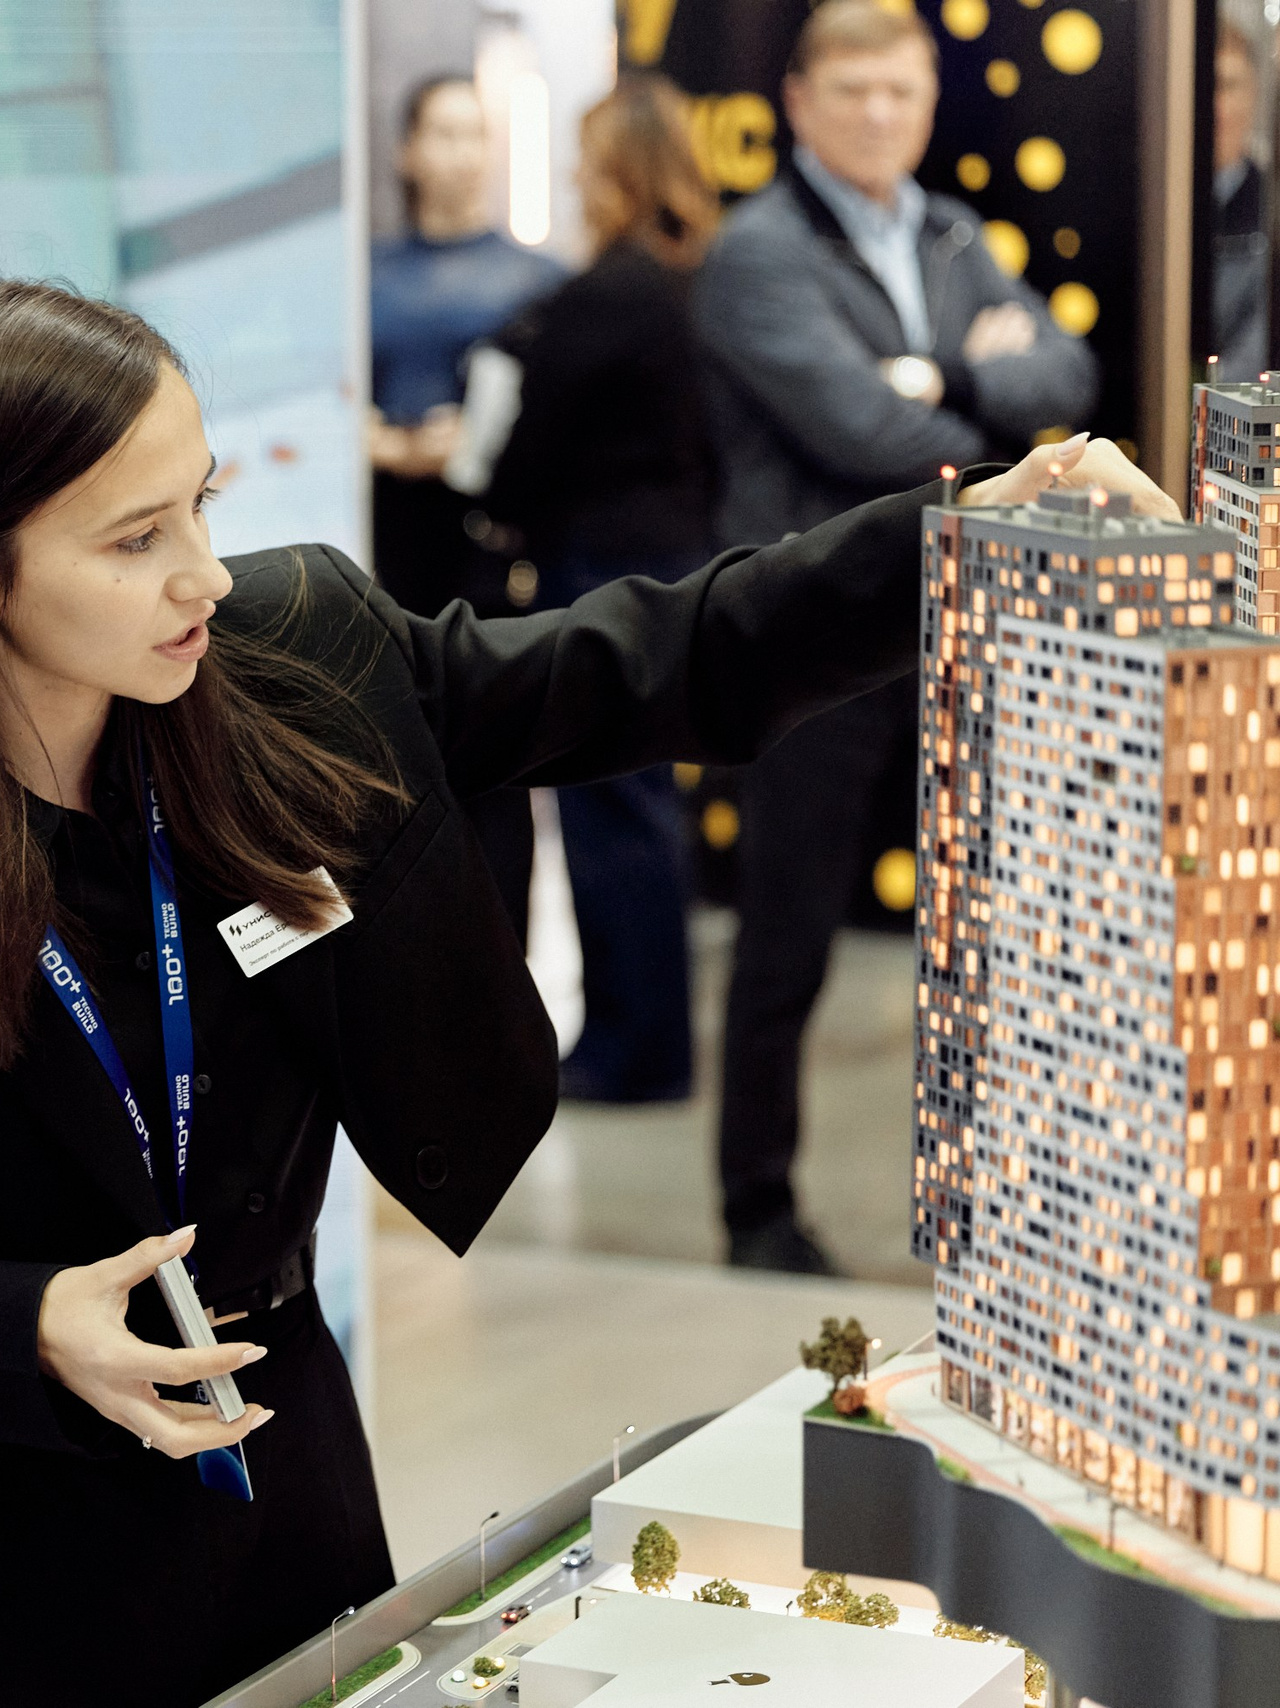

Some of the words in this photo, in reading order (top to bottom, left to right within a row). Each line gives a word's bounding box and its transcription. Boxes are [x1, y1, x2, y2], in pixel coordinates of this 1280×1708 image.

[161, 903, 170, 939] TECHNO
[167, 903, 178, 938] BUILD
[242, 910, 273, 929] УНИС
[240, 929, 274, 951] Надежда
[249, 952, 269, 966] Эксперт
[278, 940, 294, 951] работе
[38, 939, 81, 993] 100+
[161, 944, 184, 1005] 100+
[72, 1001, 94, 1034] BUILD
[80, 996, 98, 1029] TECHNO
[175, 1075, 184, 1111] TECHNO
[182, 1074, 190, 1110] BUILD
[124, 1087, 150, 1143] 100+
[176, 1115, 189, 1176] 100+
